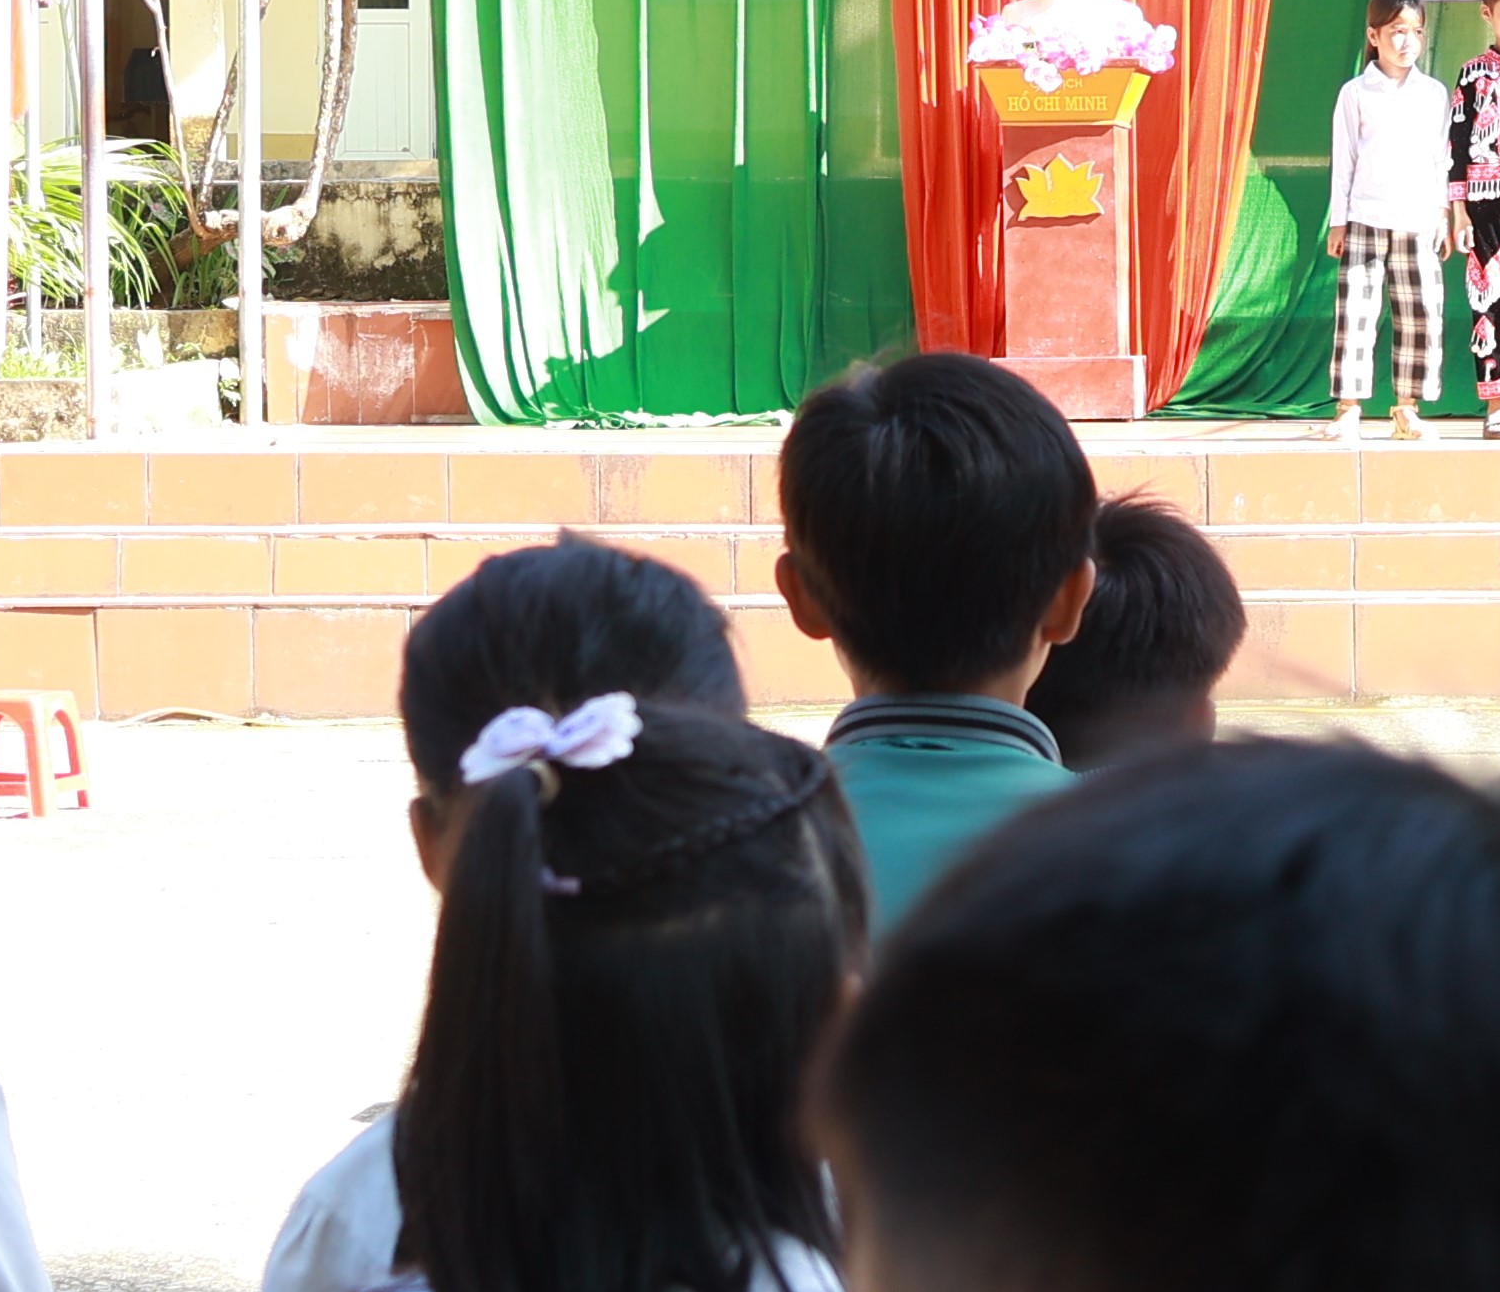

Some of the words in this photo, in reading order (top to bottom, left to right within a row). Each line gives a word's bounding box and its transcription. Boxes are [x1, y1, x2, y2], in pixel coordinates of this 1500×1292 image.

[1007, 91, 1030, 111] HỒ
[1033, 91, 1060, 111] CHÍ
[1064, 96, 1108, 111] MINH
